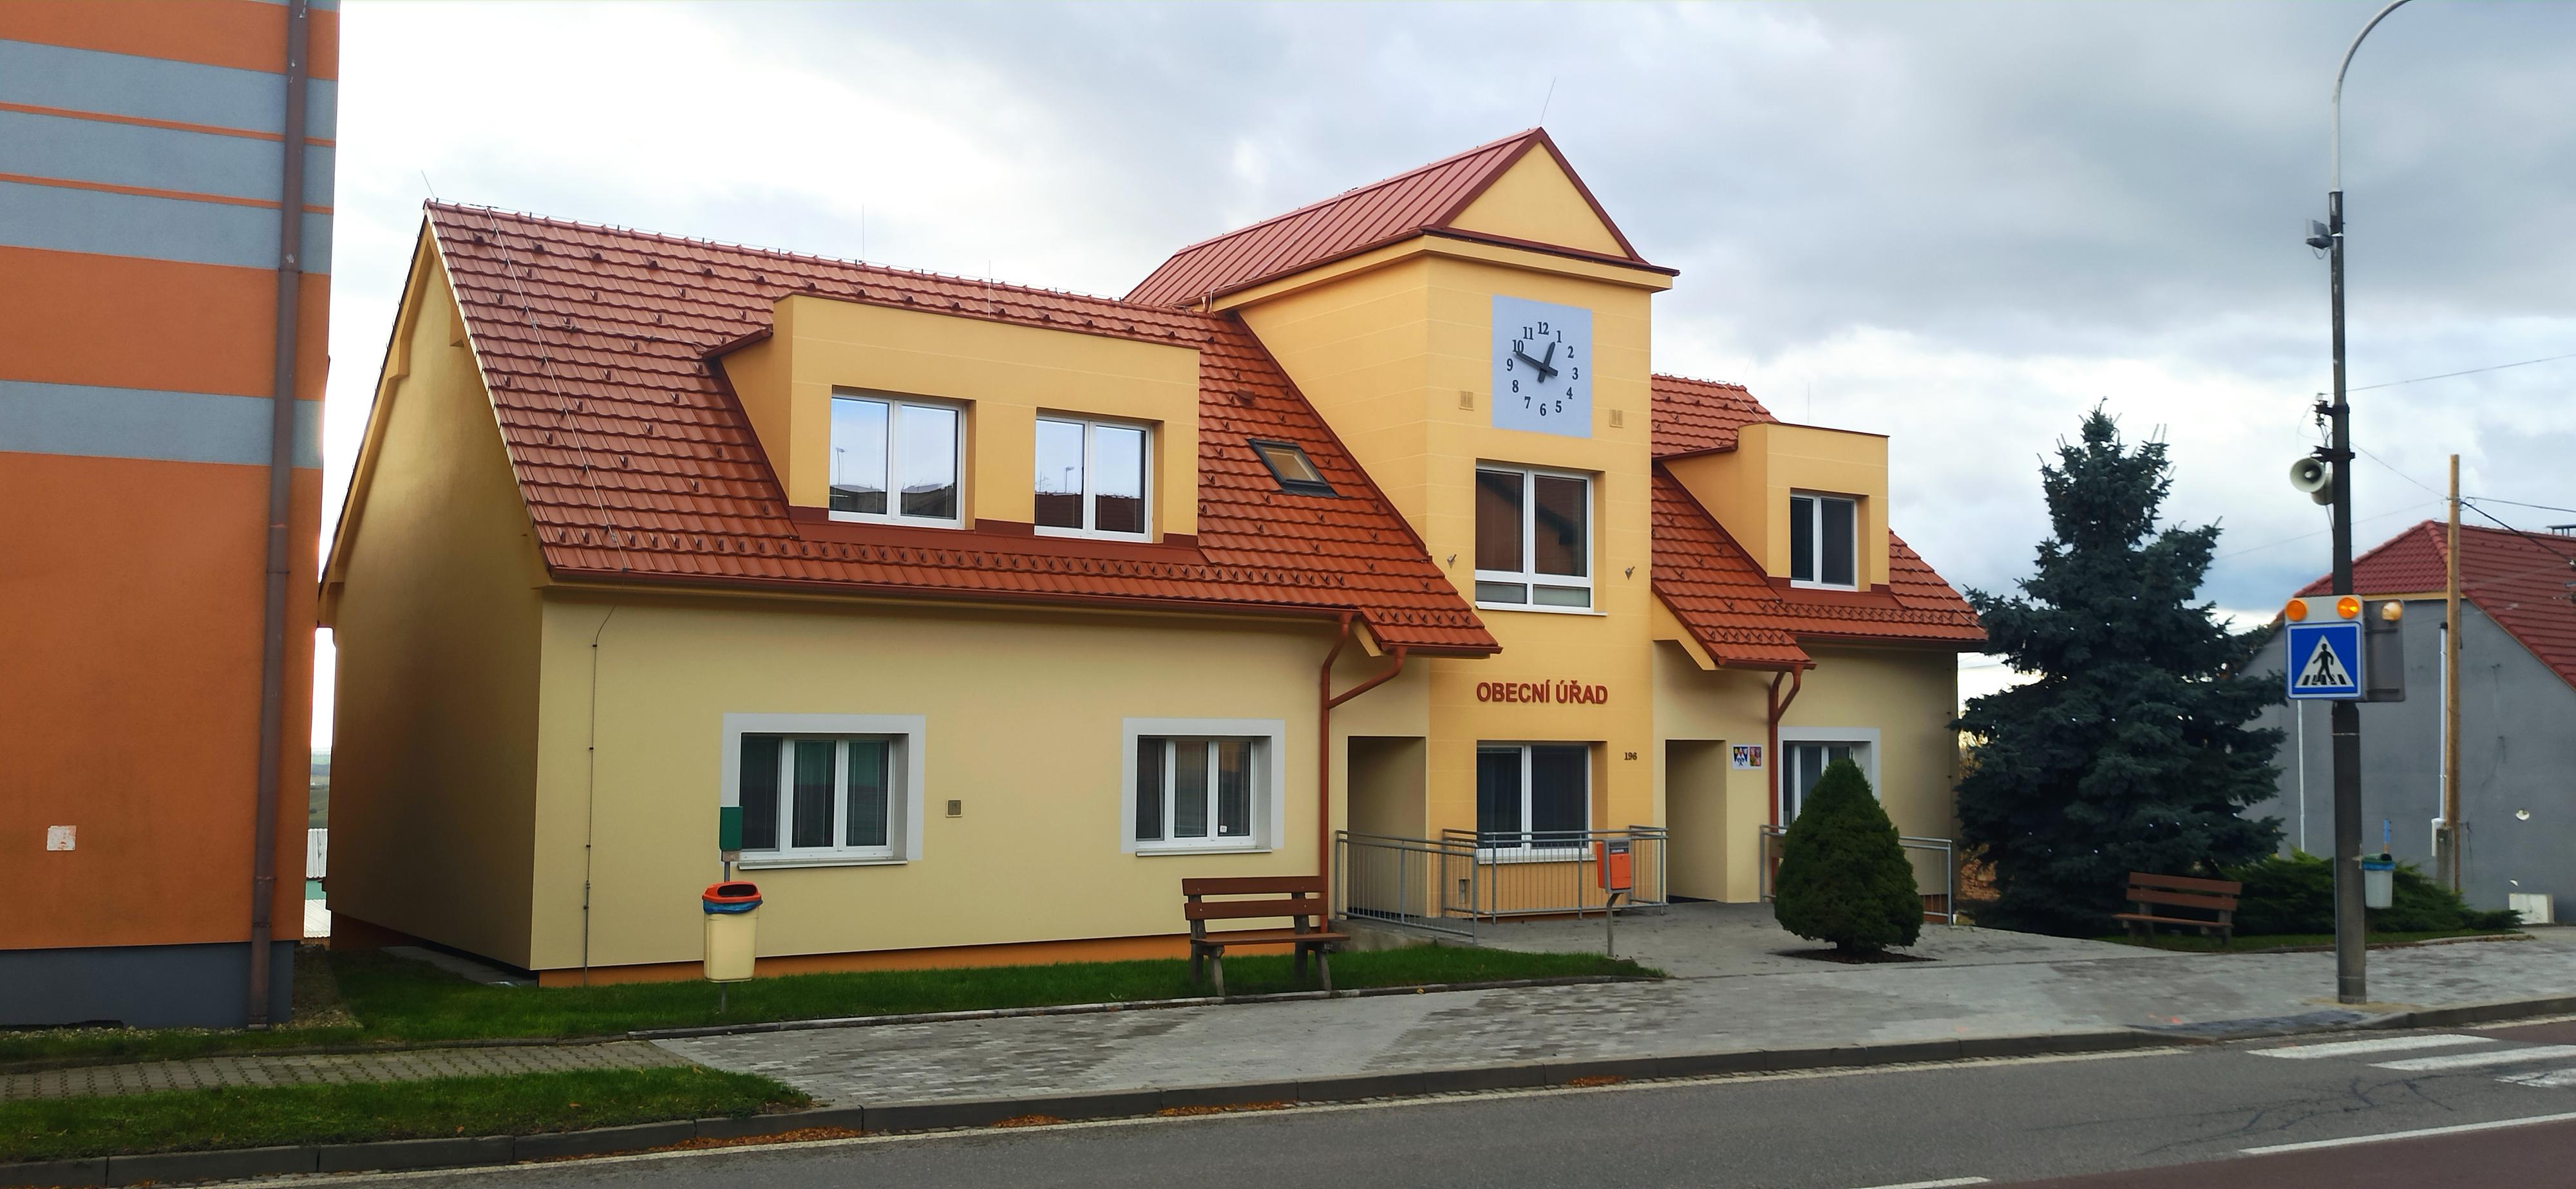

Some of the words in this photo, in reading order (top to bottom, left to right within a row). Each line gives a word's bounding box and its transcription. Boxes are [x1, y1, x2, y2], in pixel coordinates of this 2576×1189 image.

[1523, 326, 1533, 341] 11
[1538, 321, 1549, 335] 12
[1557, 330, 1562, 343] 1
[1512, 339, 1524, 353] 10
[1567, 345, 1575, 359] 2
[1506, 358, 1513, 372] 9
[1572, 367, 1578, 380] 3
[1512, 379, 1519, 393] 8
[1566, 386, 1573, 400] 4
[1524, 396, 1531, 409] 7
[1555, 400, 1562, 413] 5
[1540, 403, 1547, 417] 6
[1476, 679, 1551, 704] OBECNÍ
[1555, 679, 1608, 705] ÚŘAD
[1624, 752, 1638, 761] 196
